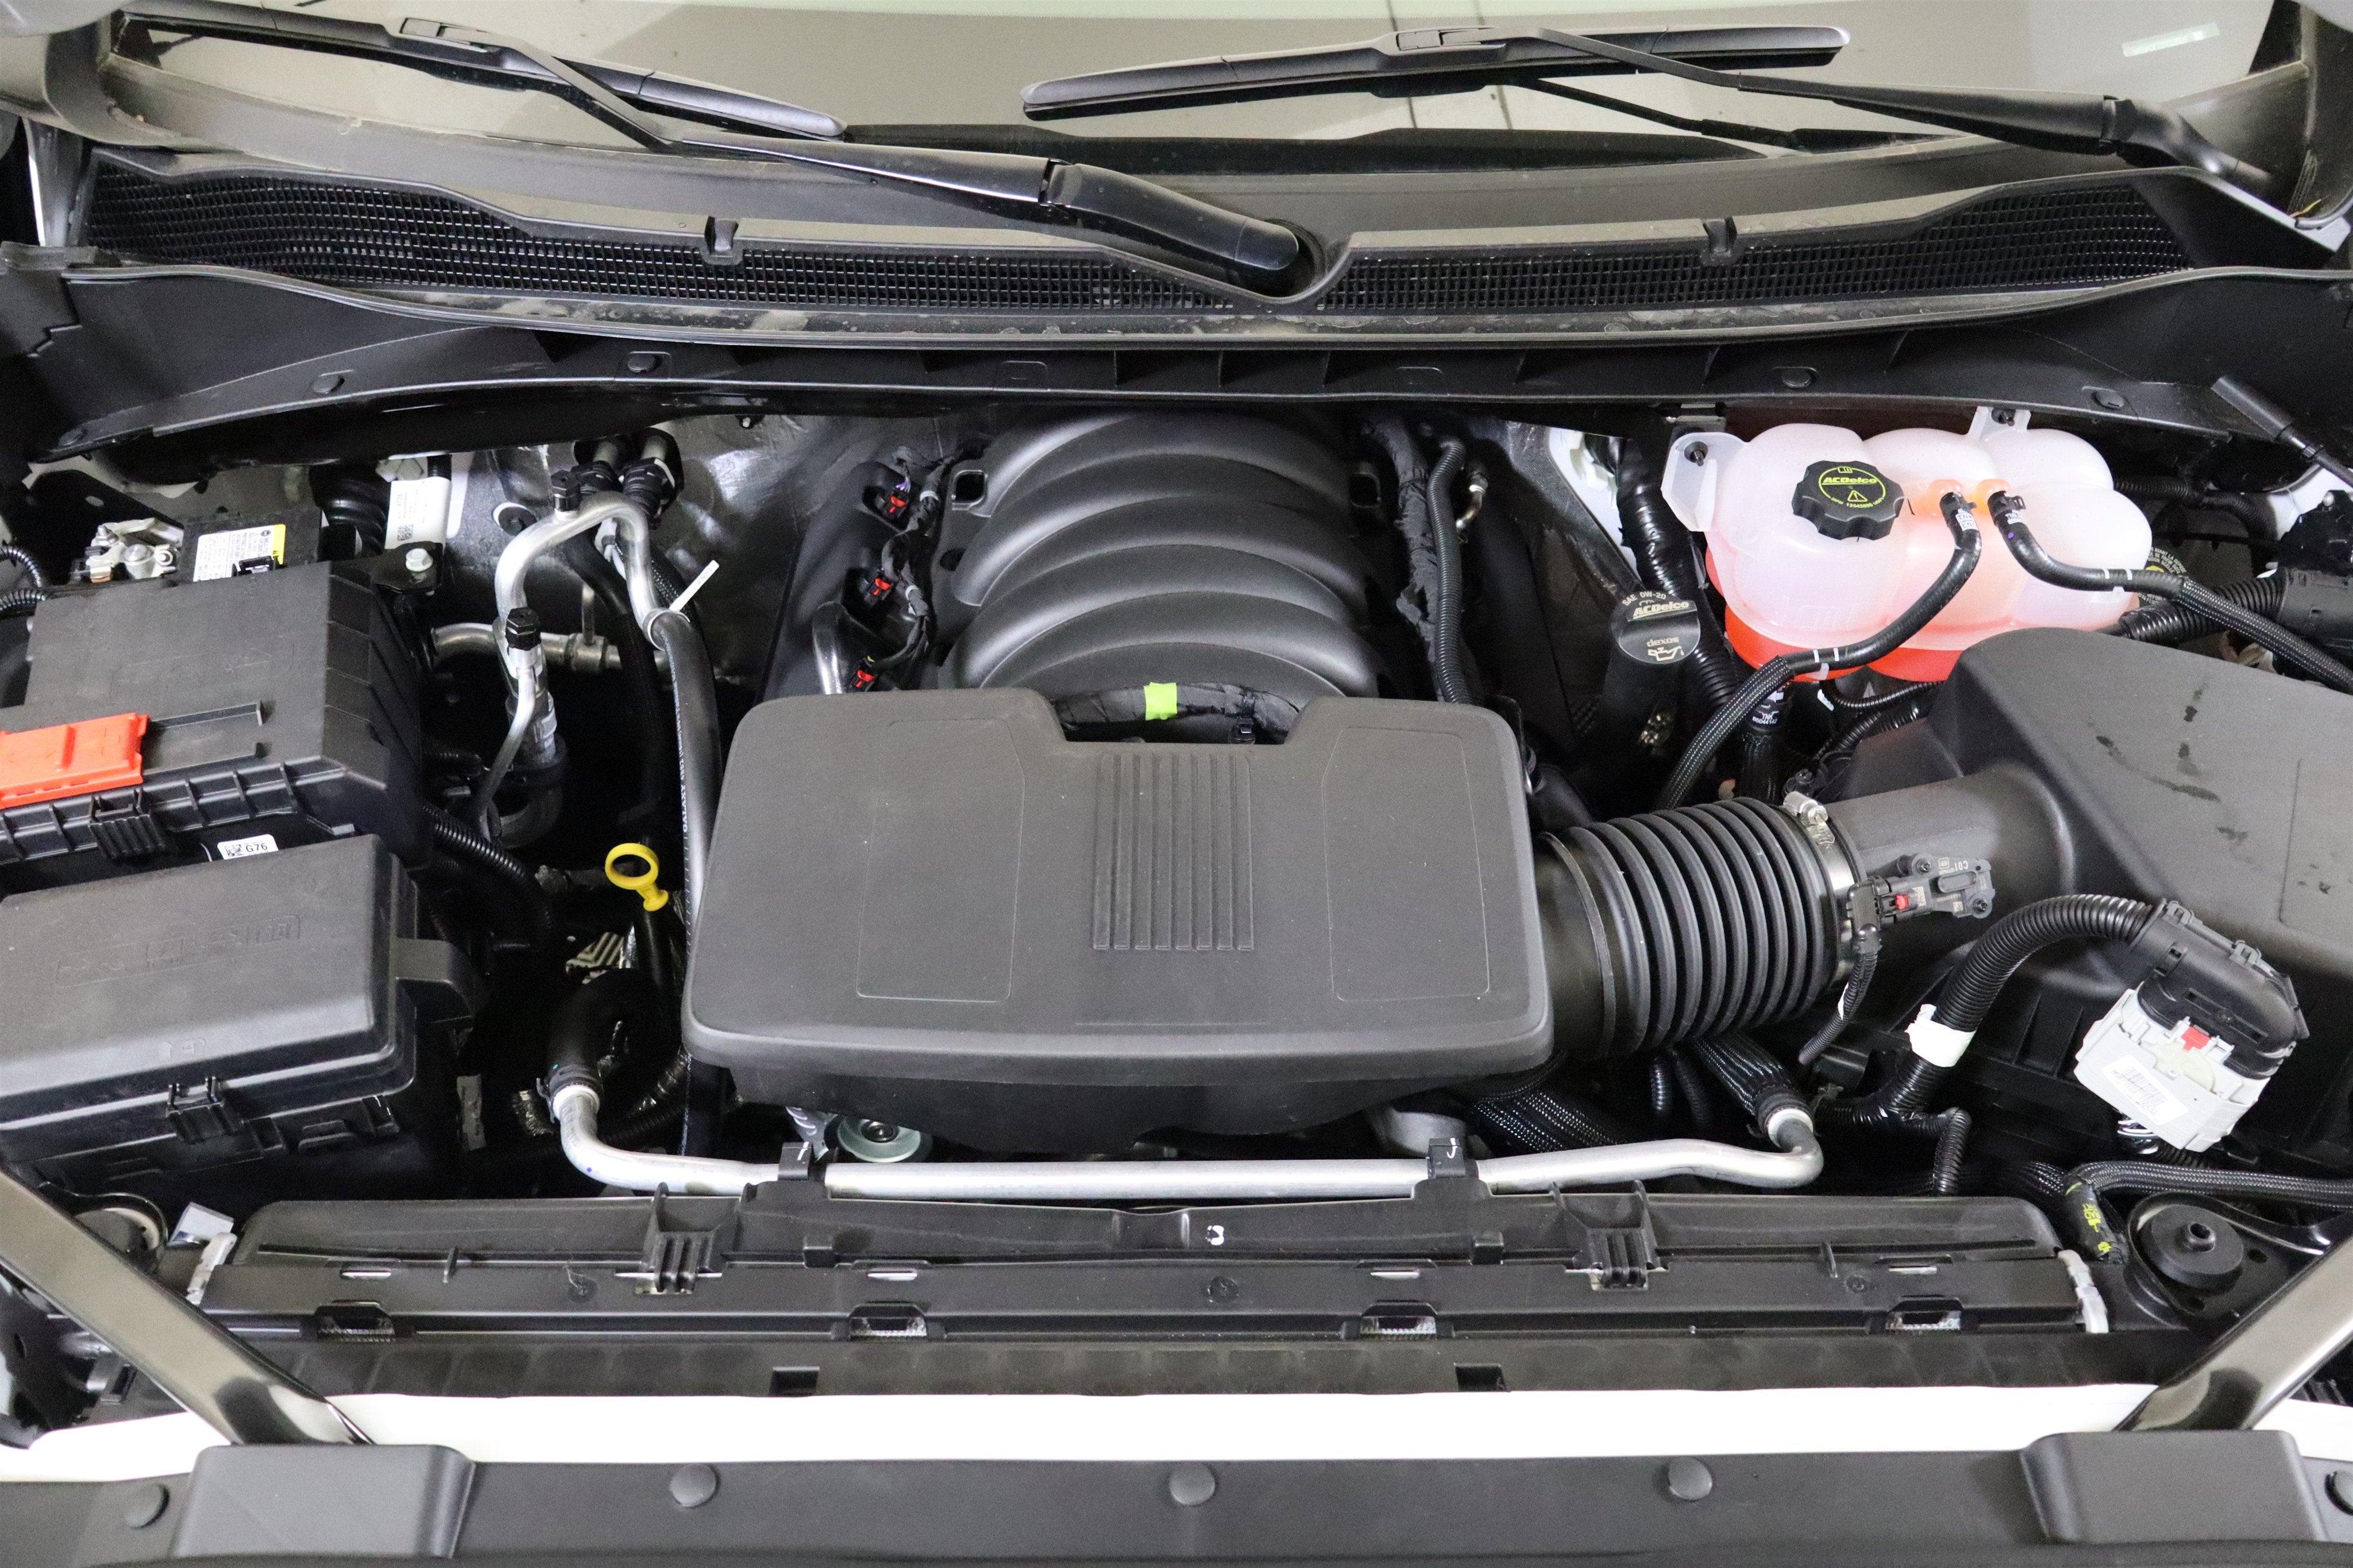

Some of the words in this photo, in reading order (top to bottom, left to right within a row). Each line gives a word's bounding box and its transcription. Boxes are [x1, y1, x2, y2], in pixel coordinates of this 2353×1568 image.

[1622, 594, 1638, 606] SAE
[1640, 591, 1666, 600] 0W-20
[1633, 601, 1689, 617] ACDelco
[1646, 637, 1679, 647] dexos
[246, 843, 268, 852] G76
[1955, 860, 1969, 872] C01
